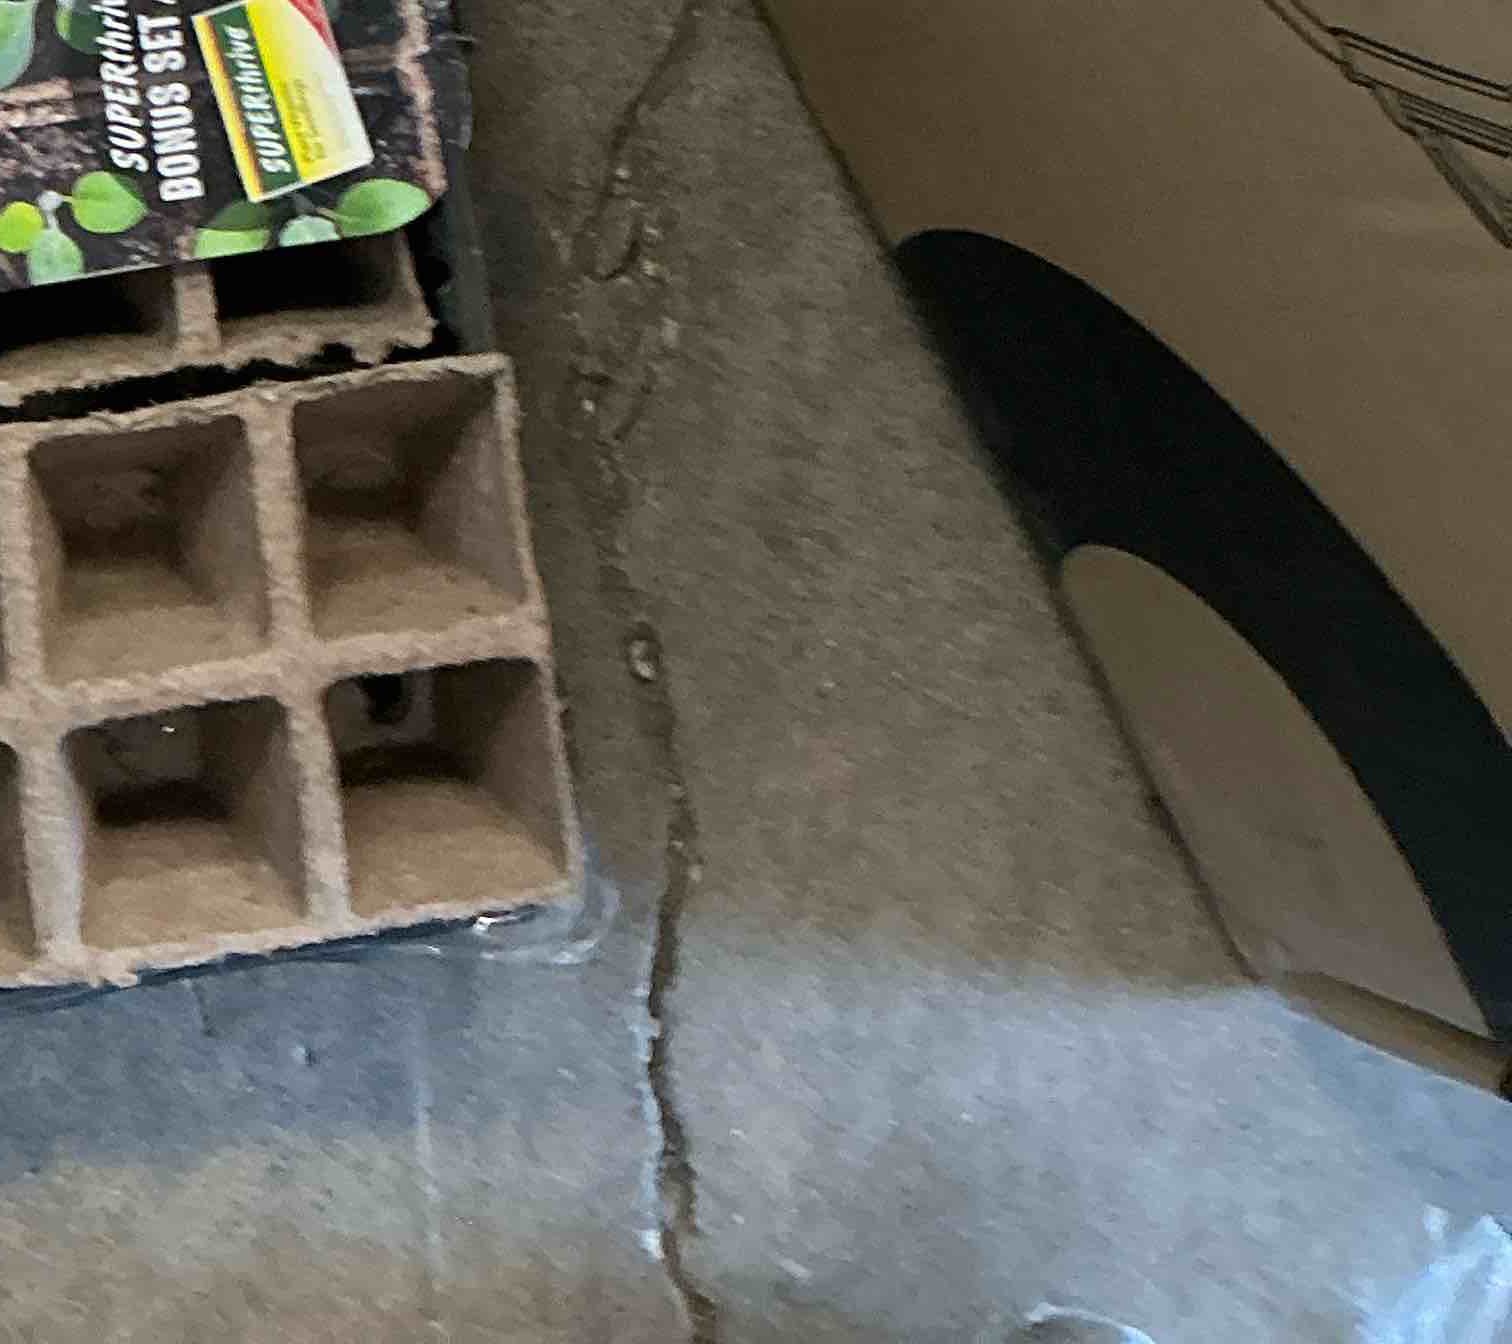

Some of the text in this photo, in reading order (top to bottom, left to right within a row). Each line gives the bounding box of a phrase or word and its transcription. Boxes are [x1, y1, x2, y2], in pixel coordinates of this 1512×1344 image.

[133, 7, 189, 76] SET
[215, 16, 293, 180] SUPERthrive
[140, 79, 208, 203] BONUS
